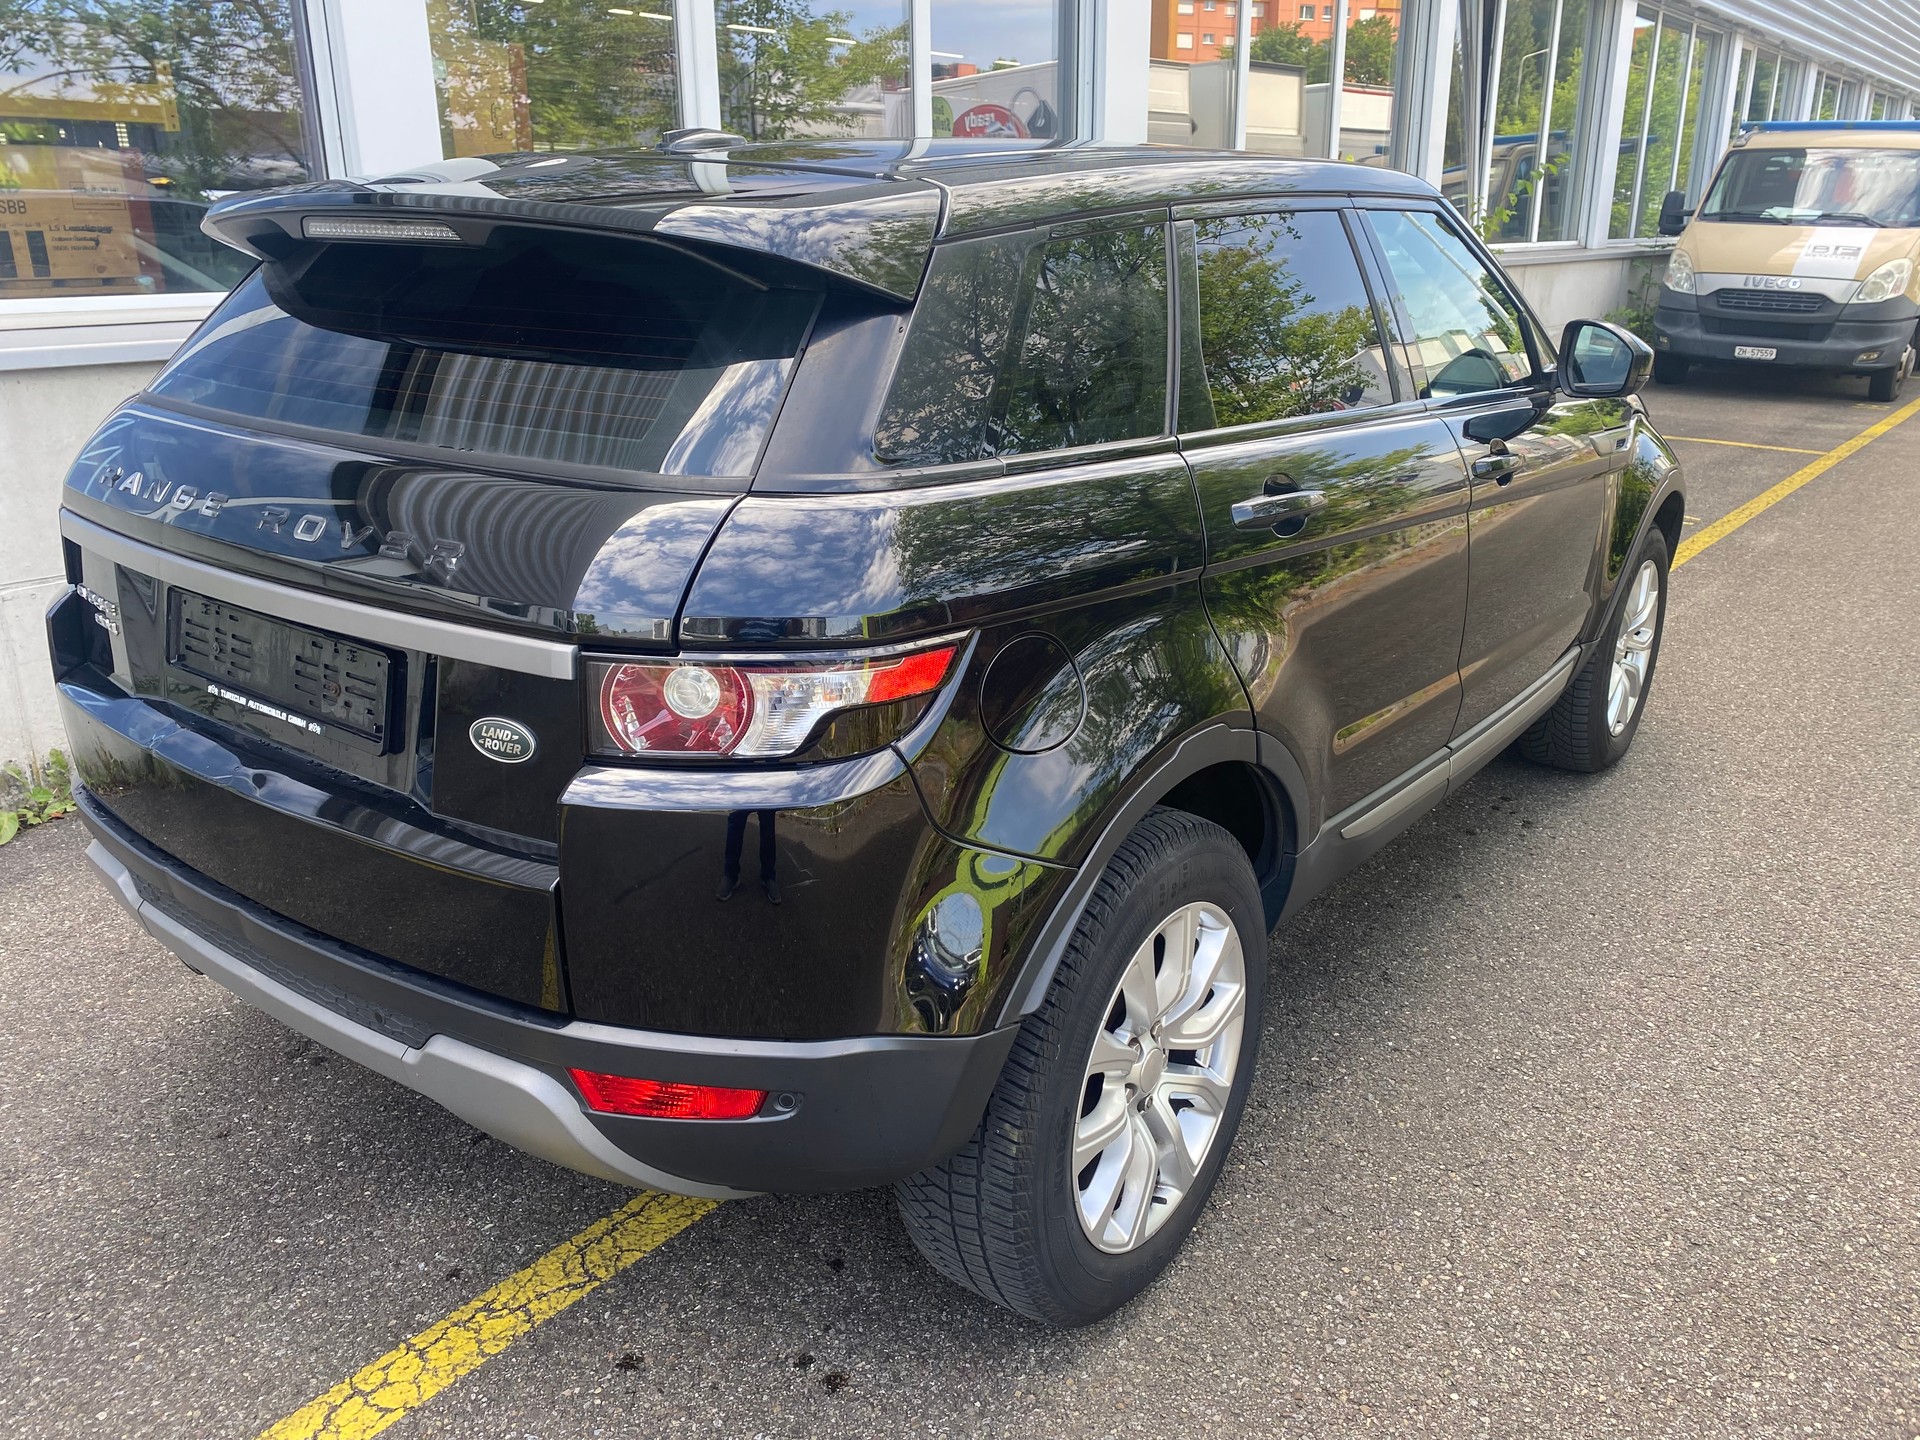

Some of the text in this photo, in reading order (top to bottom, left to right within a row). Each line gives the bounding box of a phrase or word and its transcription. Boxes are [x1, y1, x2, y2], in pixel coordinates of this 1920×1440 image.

[1743, 275, 1801, 290] IVECO
[99, 464, 465, 572] RANGE ROVER
[481, 725, 512, 742] LAND
[484, 737, 522, 755] ROVER
